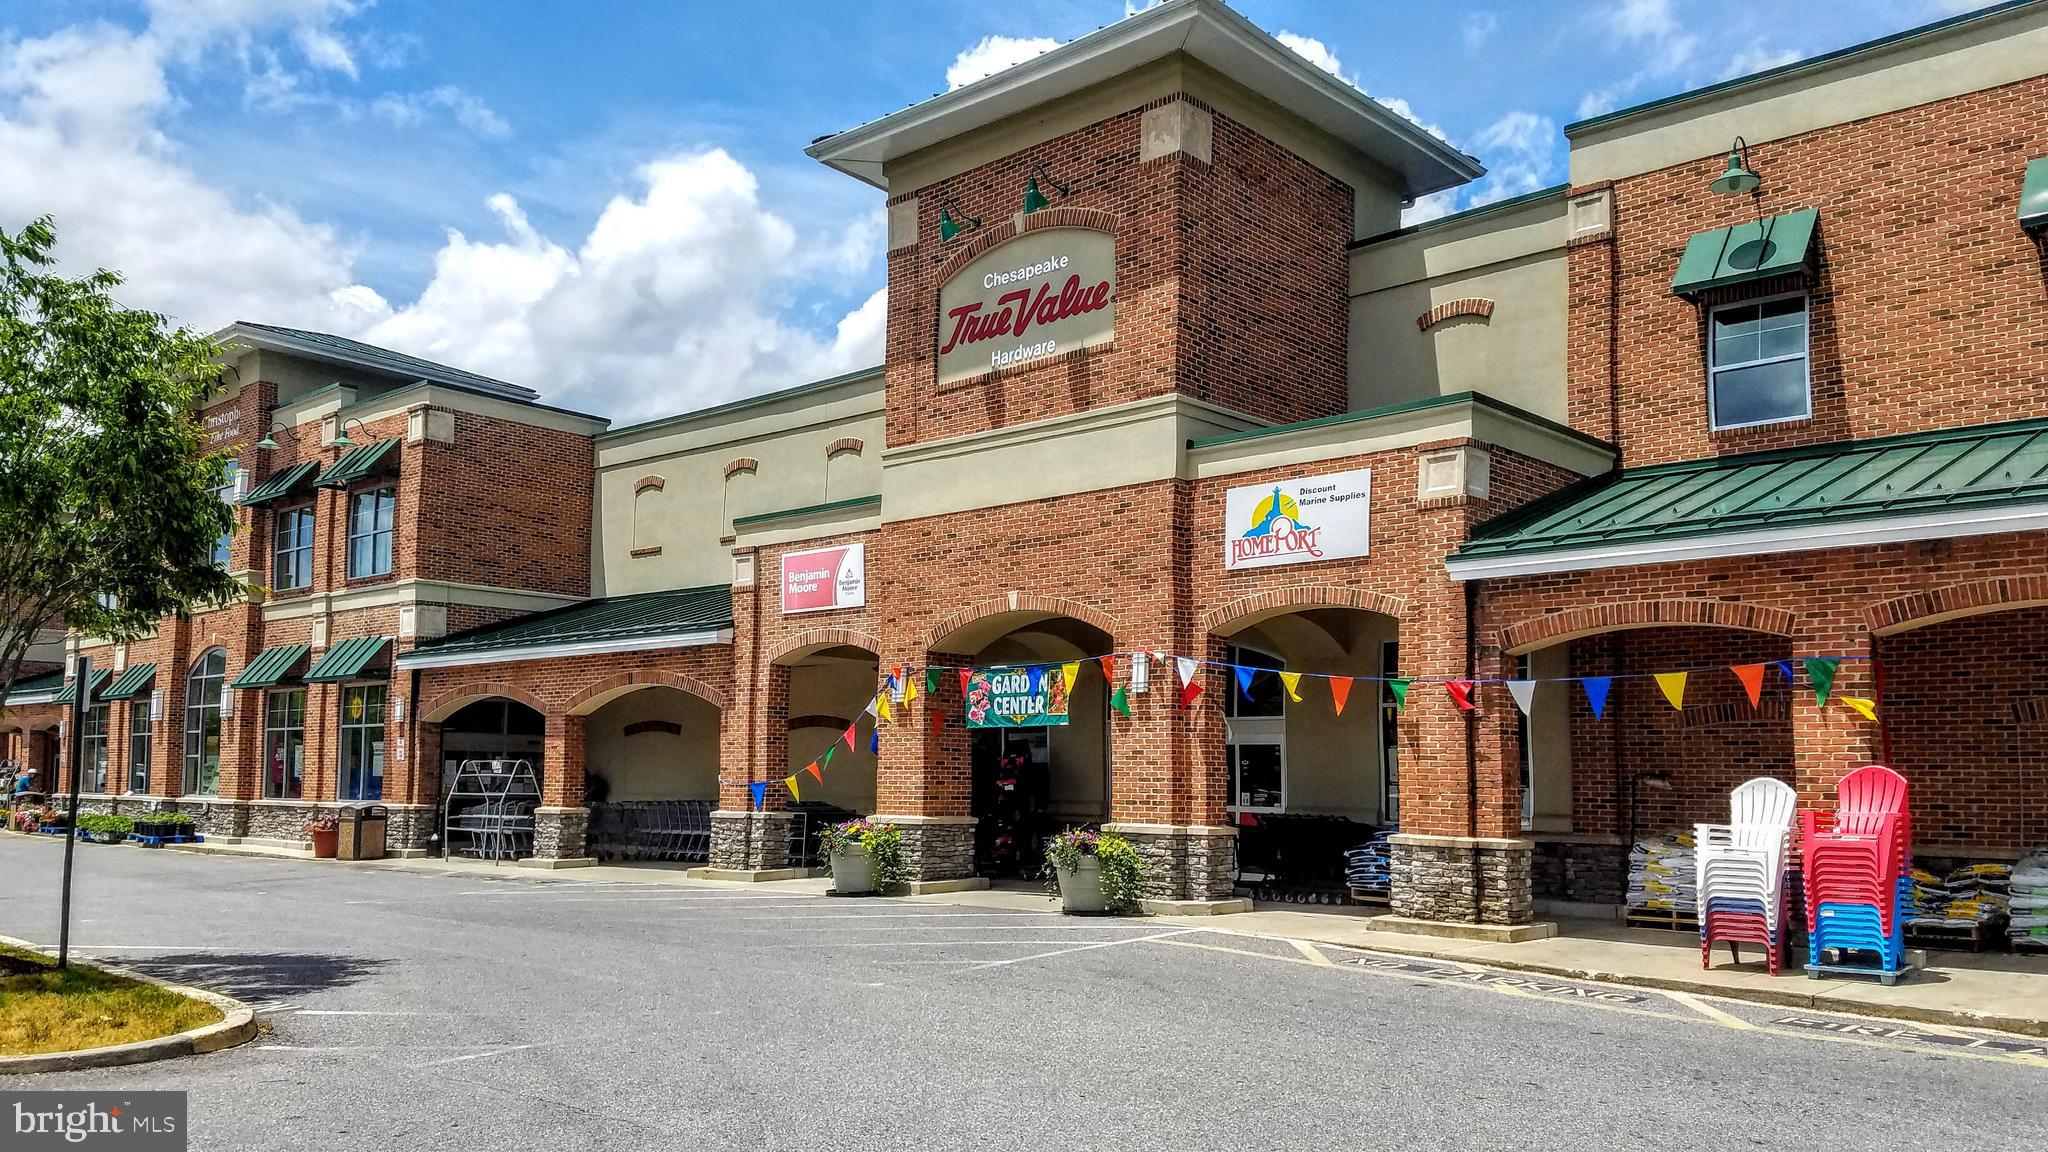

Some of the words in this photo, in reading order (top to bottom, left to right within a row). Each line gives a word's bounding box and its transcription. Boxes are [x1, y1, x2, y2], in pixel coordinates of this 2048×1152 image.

[983, 254, 1069, 289] Chesapeake
[940, 302, 1013, 355] True
[998, 274, 1112, 337] Value
[991, 339, 1056, 367] Hardware
[1299, 484, 1336, 496] Discount
[1299, 496, 1327, 507] Marine
[1329, 491, 1366, 503] Supplies
[788, 567, 830, 584] Benjamin
[788, 582, 818, 595] Moore
[991, 673, 1049, 695] GARDN
[993, 695, 1045, 715] CENTER
[1421, 967, 1637, 1002] PARKING
[1774, 1017, 1935, 1041] FIRE
